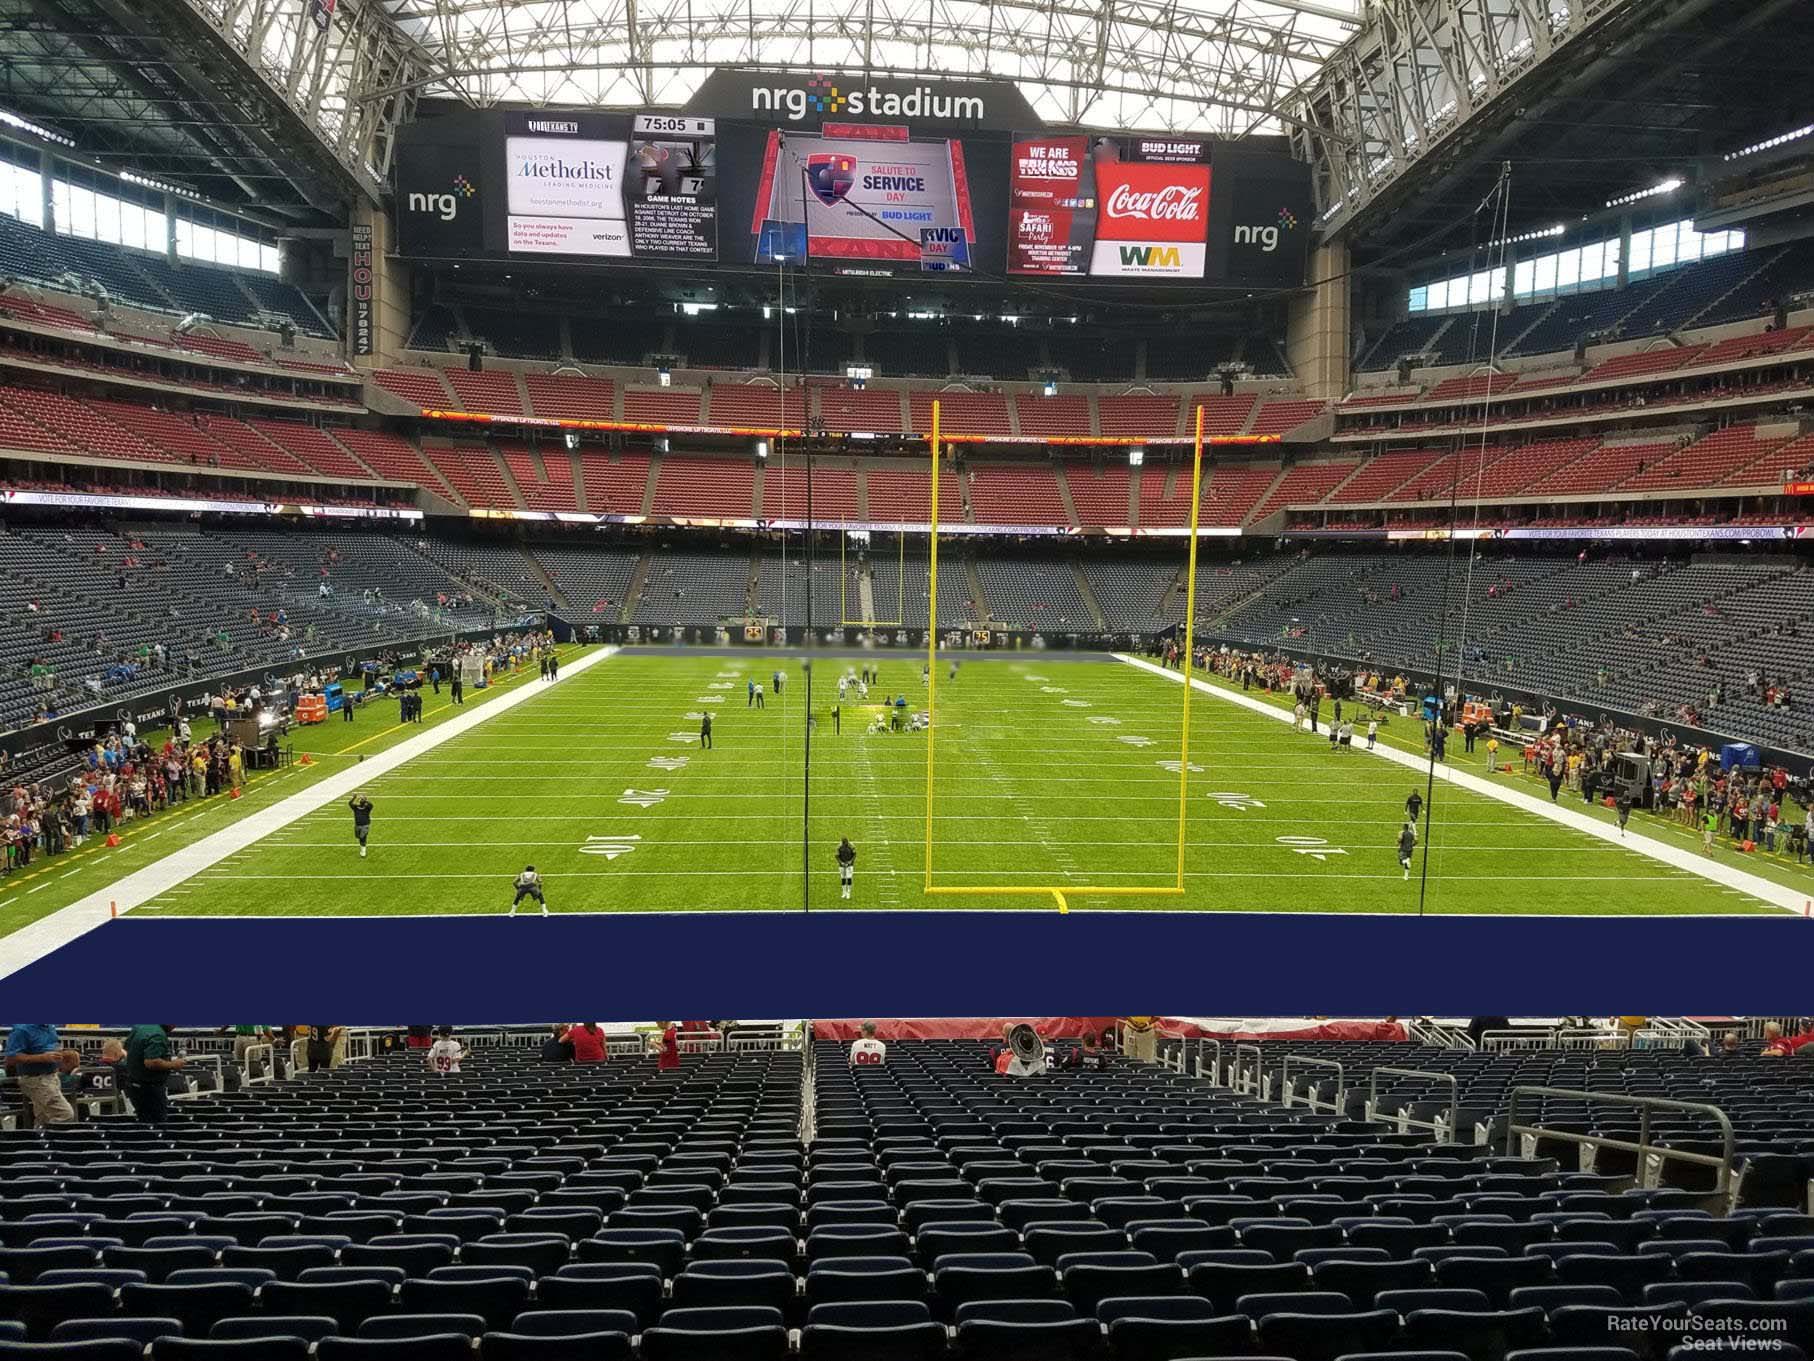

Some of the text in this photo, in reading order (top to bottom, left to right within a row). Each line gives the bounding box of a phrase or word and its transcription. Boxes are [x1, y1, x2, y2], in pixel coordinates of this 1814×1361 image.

[753, 87, 984, 120] nrg stadium
[644, 118, 686, 130] 75:05
[1030, 147, 1069, 159] WE ARE
[1142, 142, 1201, 154] BUD LIGHT
[518, 160, 613, 180] Methodist
[871, 166, 916, 175] SALUTE TO
[863, 175, 925, 191] SERVICE
[886, 192, 906, 201] DAY
[1107, 183, 1203, 220] Coca-Cola
[409, 191, 457, 220] nrg
[882, 211, 932, 221] BUD LIGHT
[1020, 224, 1051, 232] SAFARI
[593, 233, 621, 241] verizon
[1234, 225, 1279, 251] nrg
[929, 243, 948, 252] DAY
[1119, 246, 1180, 266] WM
[354, 251, 372, 300] HOU
[1529, 530, 1543, 538] VOTE
[1544, 530, 1552, 538] FOR
[1554, 530, 1567, 538] YOUR
[1569, 530, 1592, 538] FAVORITE
[136, 708, 166, 723] TEXANS
[617, 788, 671, 804] 20
[1206, 792, 1267, 808] 20
[578, 834, 642, 854] 10
[1275, 836, 1349, 855] 10
[437, 1056, 451, 1071] 99
